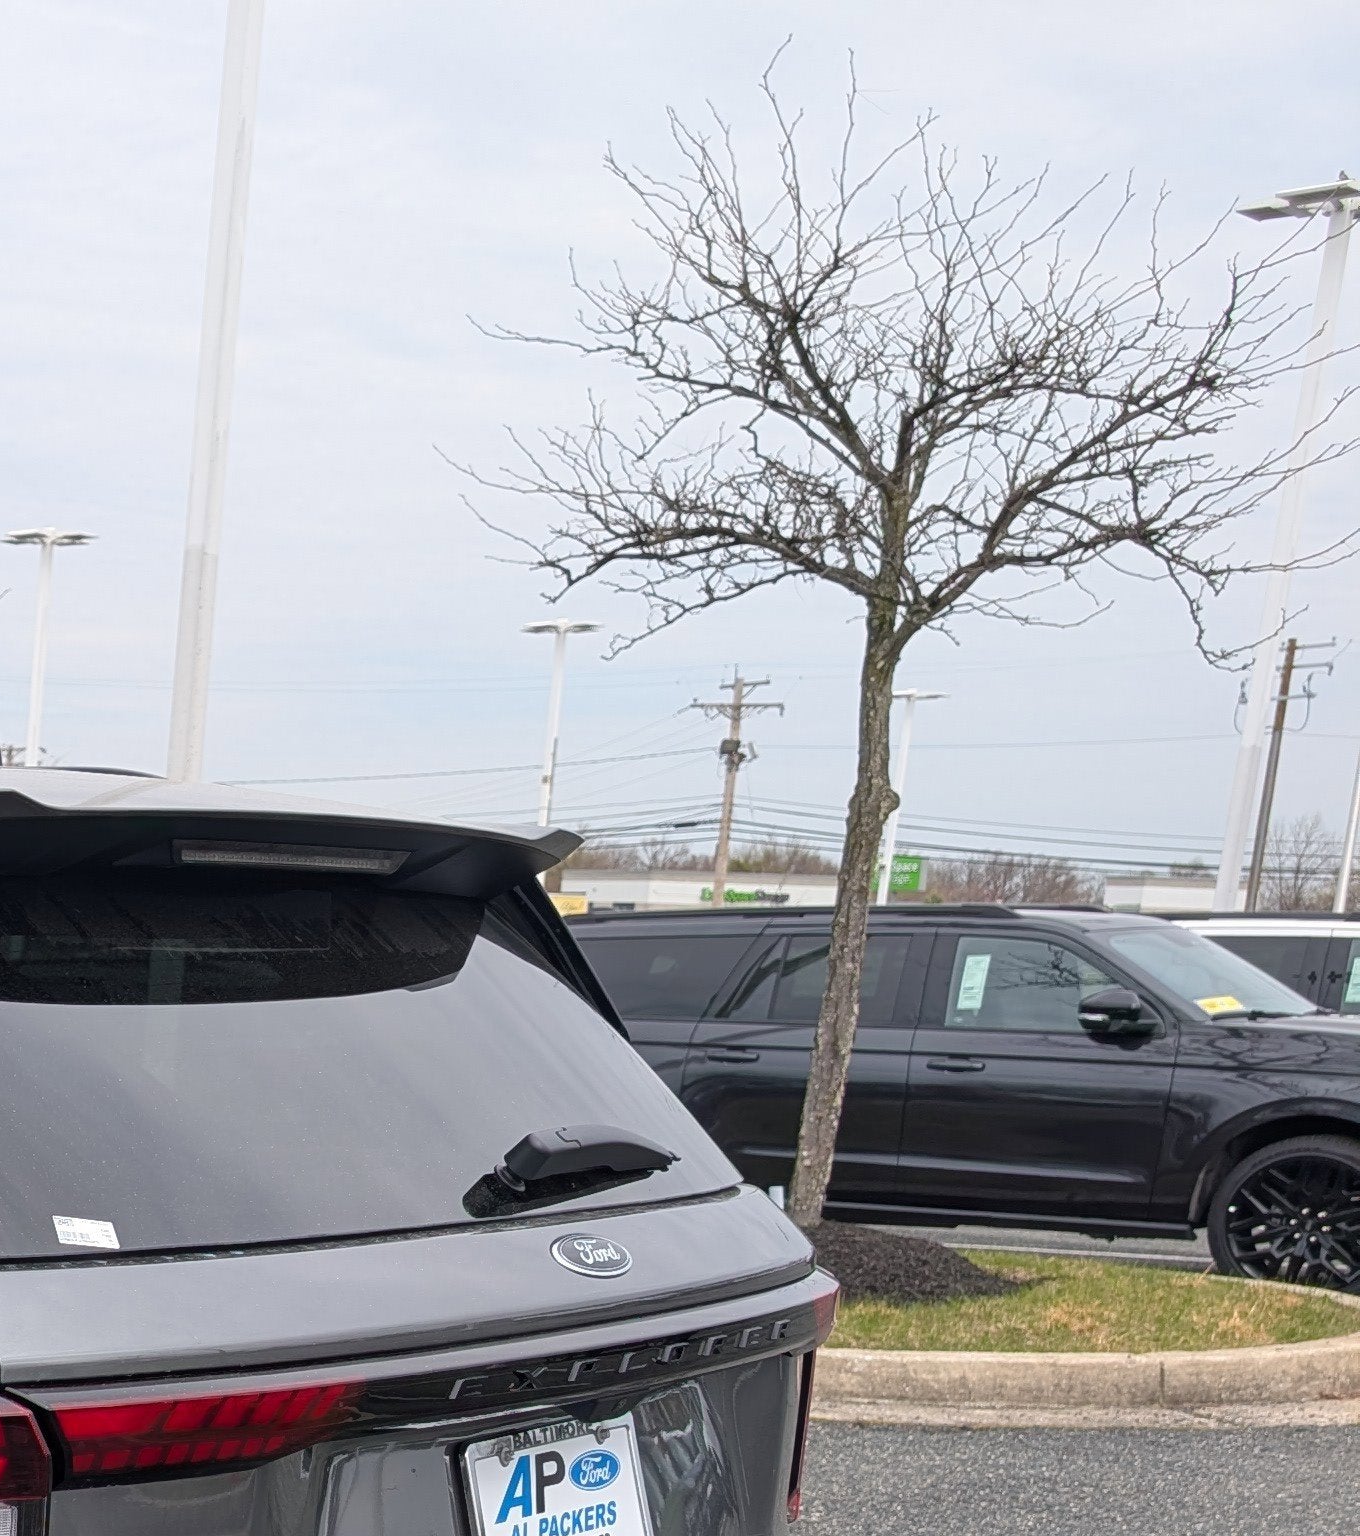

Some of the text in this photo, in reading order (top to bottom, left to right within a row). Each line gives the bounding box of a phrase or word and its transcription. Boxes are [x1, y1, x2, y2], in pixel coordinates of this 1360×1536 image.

[574, 1239, 620, 1265] Ford
[448, 1318, 792, 1400] EXPLORER
[512, 1421, 595, 1450] BALTIMORE
[495, 1450, 566, 1525] AP
